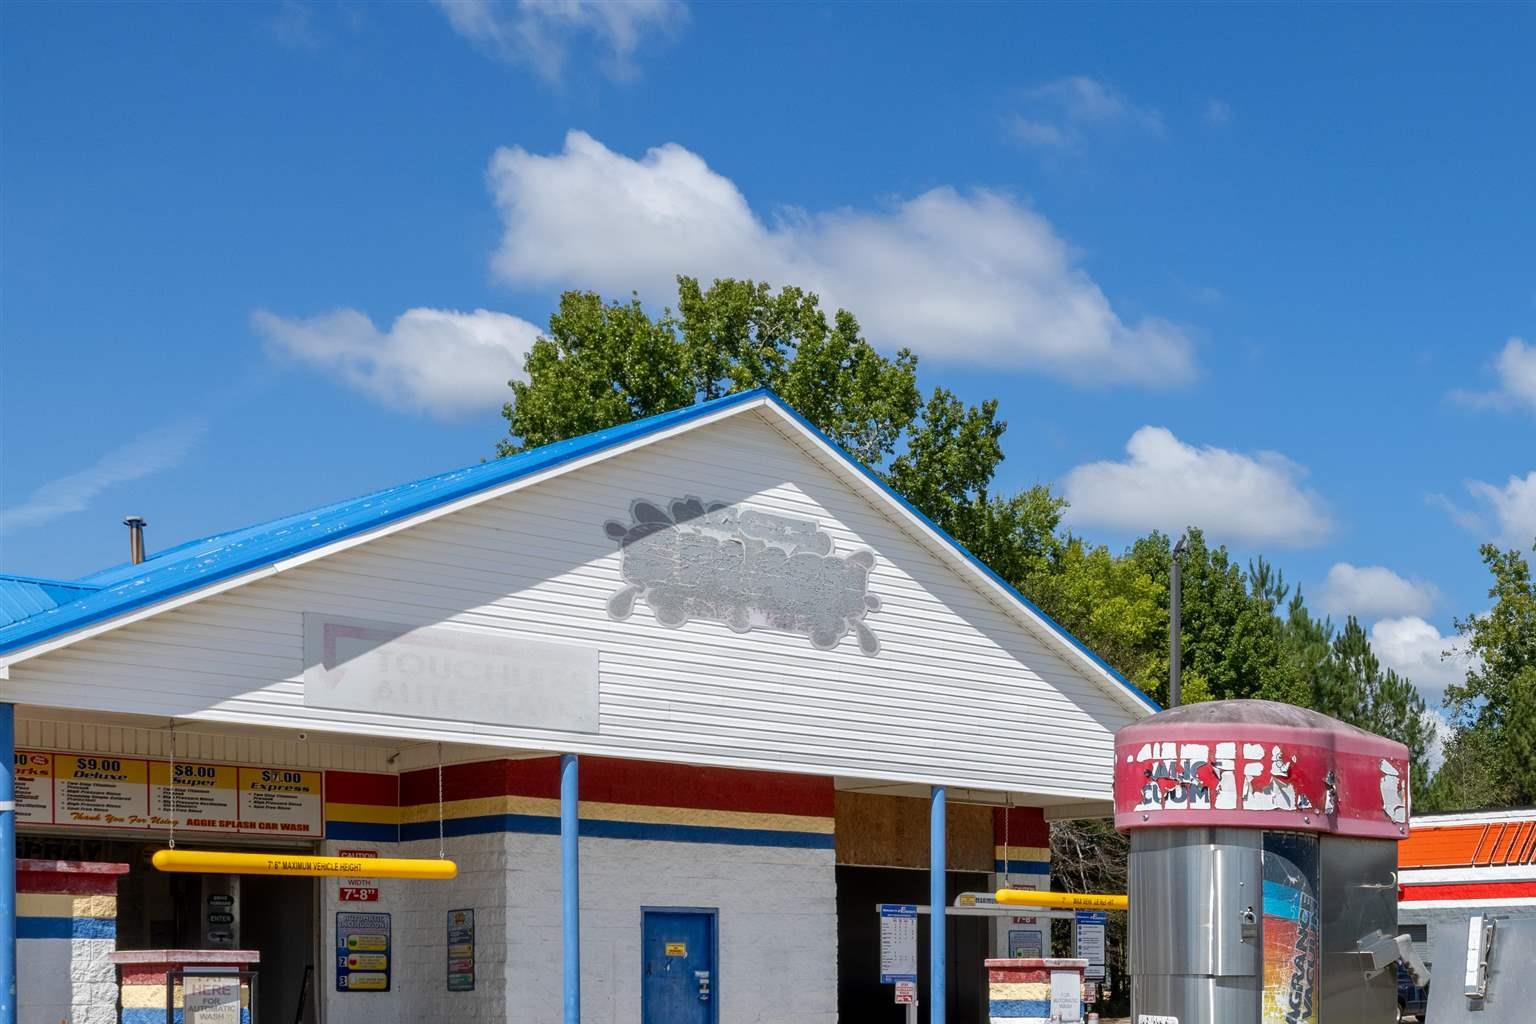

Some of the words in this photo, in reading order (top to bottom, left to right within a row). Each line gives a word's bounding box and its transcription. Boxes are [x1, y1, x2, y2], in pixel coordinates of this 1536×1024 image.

[77, 758, 121, 772] $9.00
[73, 770, 128, 781] Deluxe
[175, 765, 215, 778] $8.00
[262, 771, 301, 783] $7.00
[172, 776, 216, 787] Super
[251, 782, 310, 793] Express
[70, 812, 101, 822] Thank
[104, 814, 124, 824] You
[128, 816, 147, 824] For
[150, 816, 180, 827] Using
[186, 818, 217, 828] AGGIE
[218, 820, 256, 830] SPLASH
[258, 821, 279, 831] CAR
[280, 822, 310, 832] WASH
[282, 861, 312, 872] MAXIMUM
[314, 862, 338, 872] VEHICLE
[340, 864, 362, 872] HEIGHT
[192, 984, 232, 996] HERE
[202, 998, 221, 1006] FOR
[188, 1005, 236, 1013] AUTOMATIC
[200, 1012, 225, 1020] WASH
